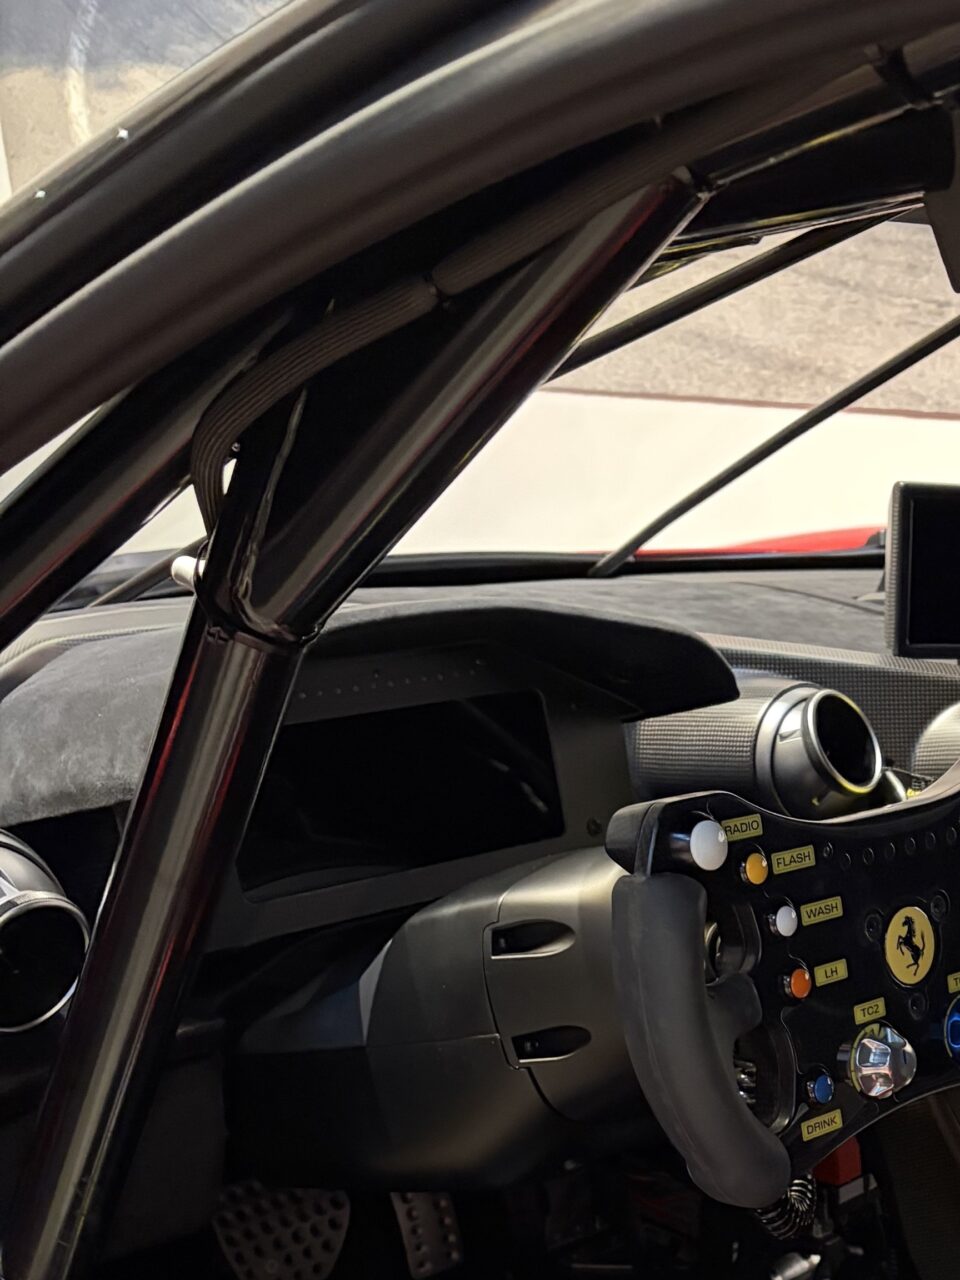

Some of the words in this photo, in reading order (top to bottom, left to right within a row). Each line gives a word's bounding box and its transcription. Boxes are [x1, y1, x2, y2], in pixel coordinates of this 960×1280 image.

[724, 819, 760, 838] RADIO
[775, 850, 812, 869] FLASH
[804, 901, 840, 919] WASH
[824, 966, 839, 979] LH
[859, 1003, 881, 1018] TC2
[805, 1114, 839, 1135] DRINK
